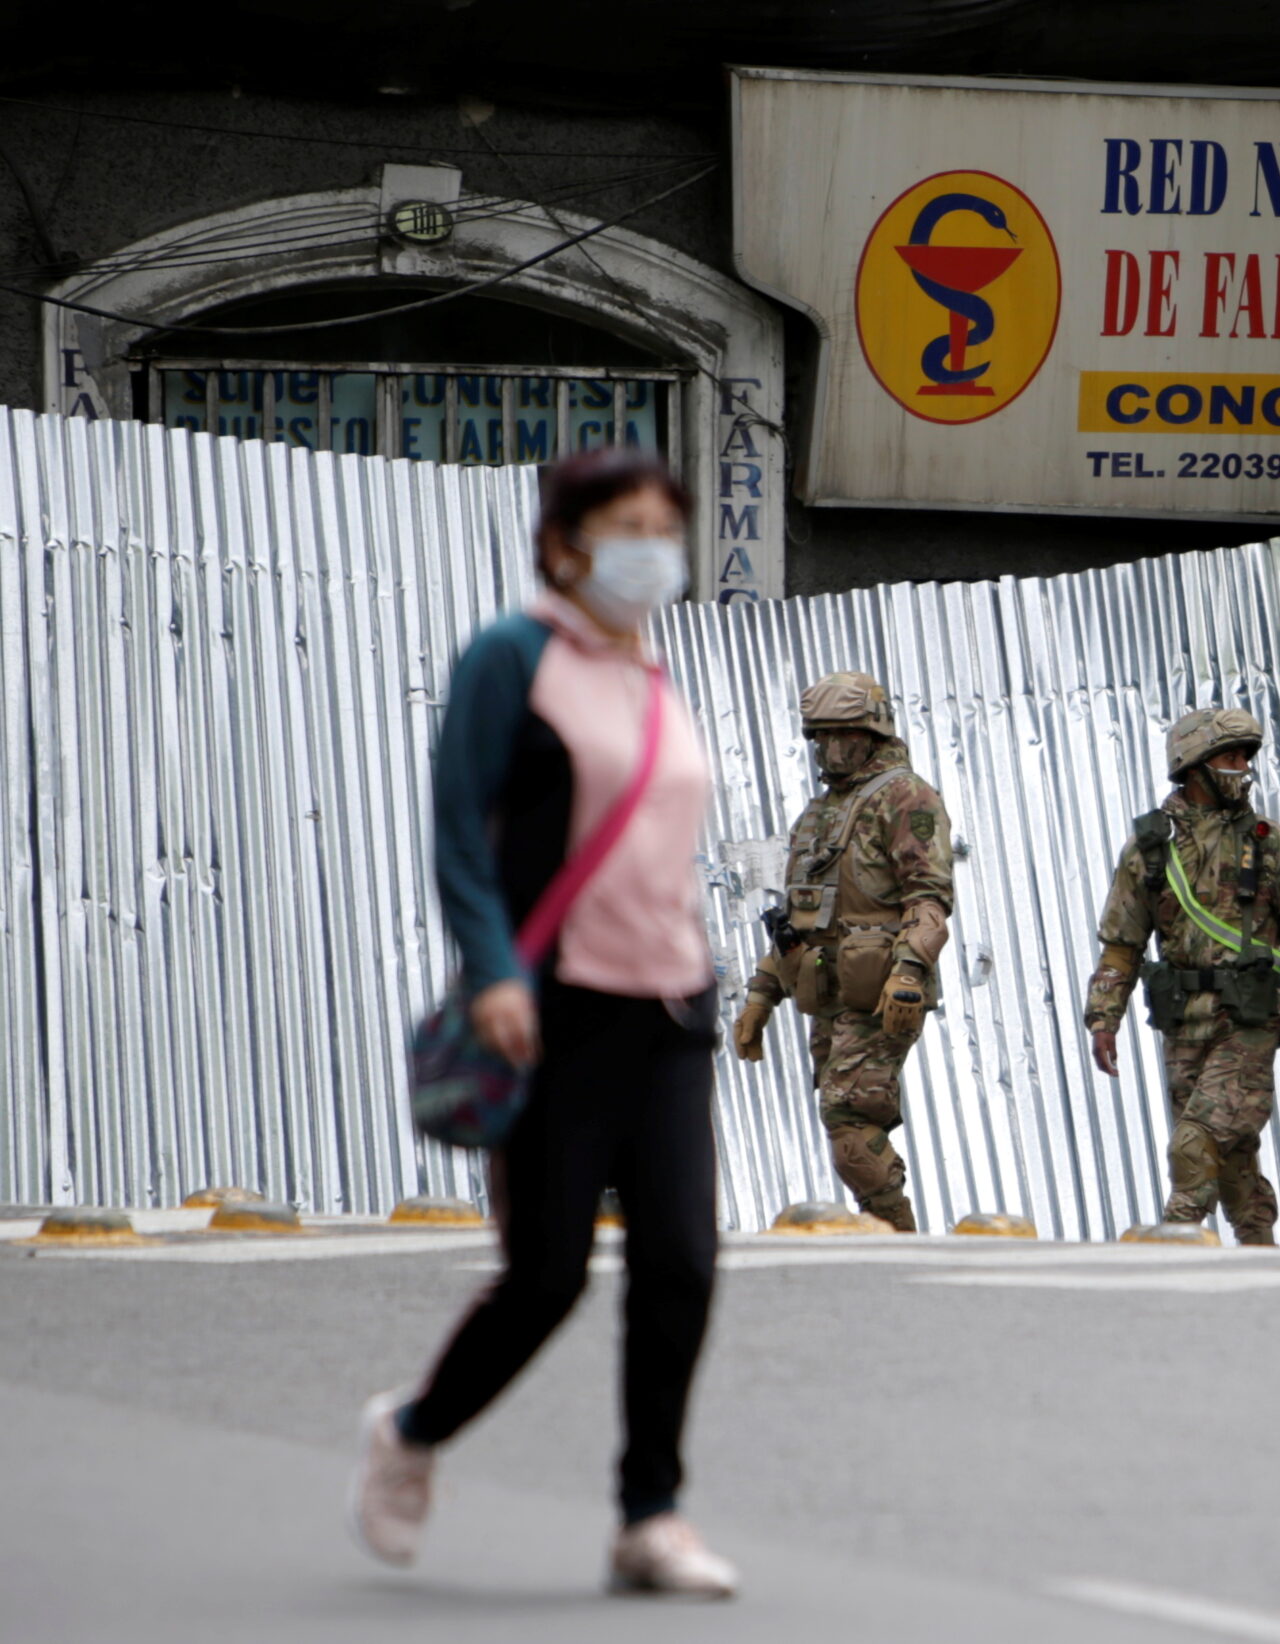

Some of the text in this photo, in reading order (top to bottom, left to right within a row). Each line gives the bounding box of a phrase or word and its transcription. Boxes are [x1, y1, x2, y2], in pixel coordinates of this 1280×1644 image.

[1100, 138, 1229, 216] RED
[1100, 249, 1181, 338] DE
[1086, 451, 1165, 478] TEL.
